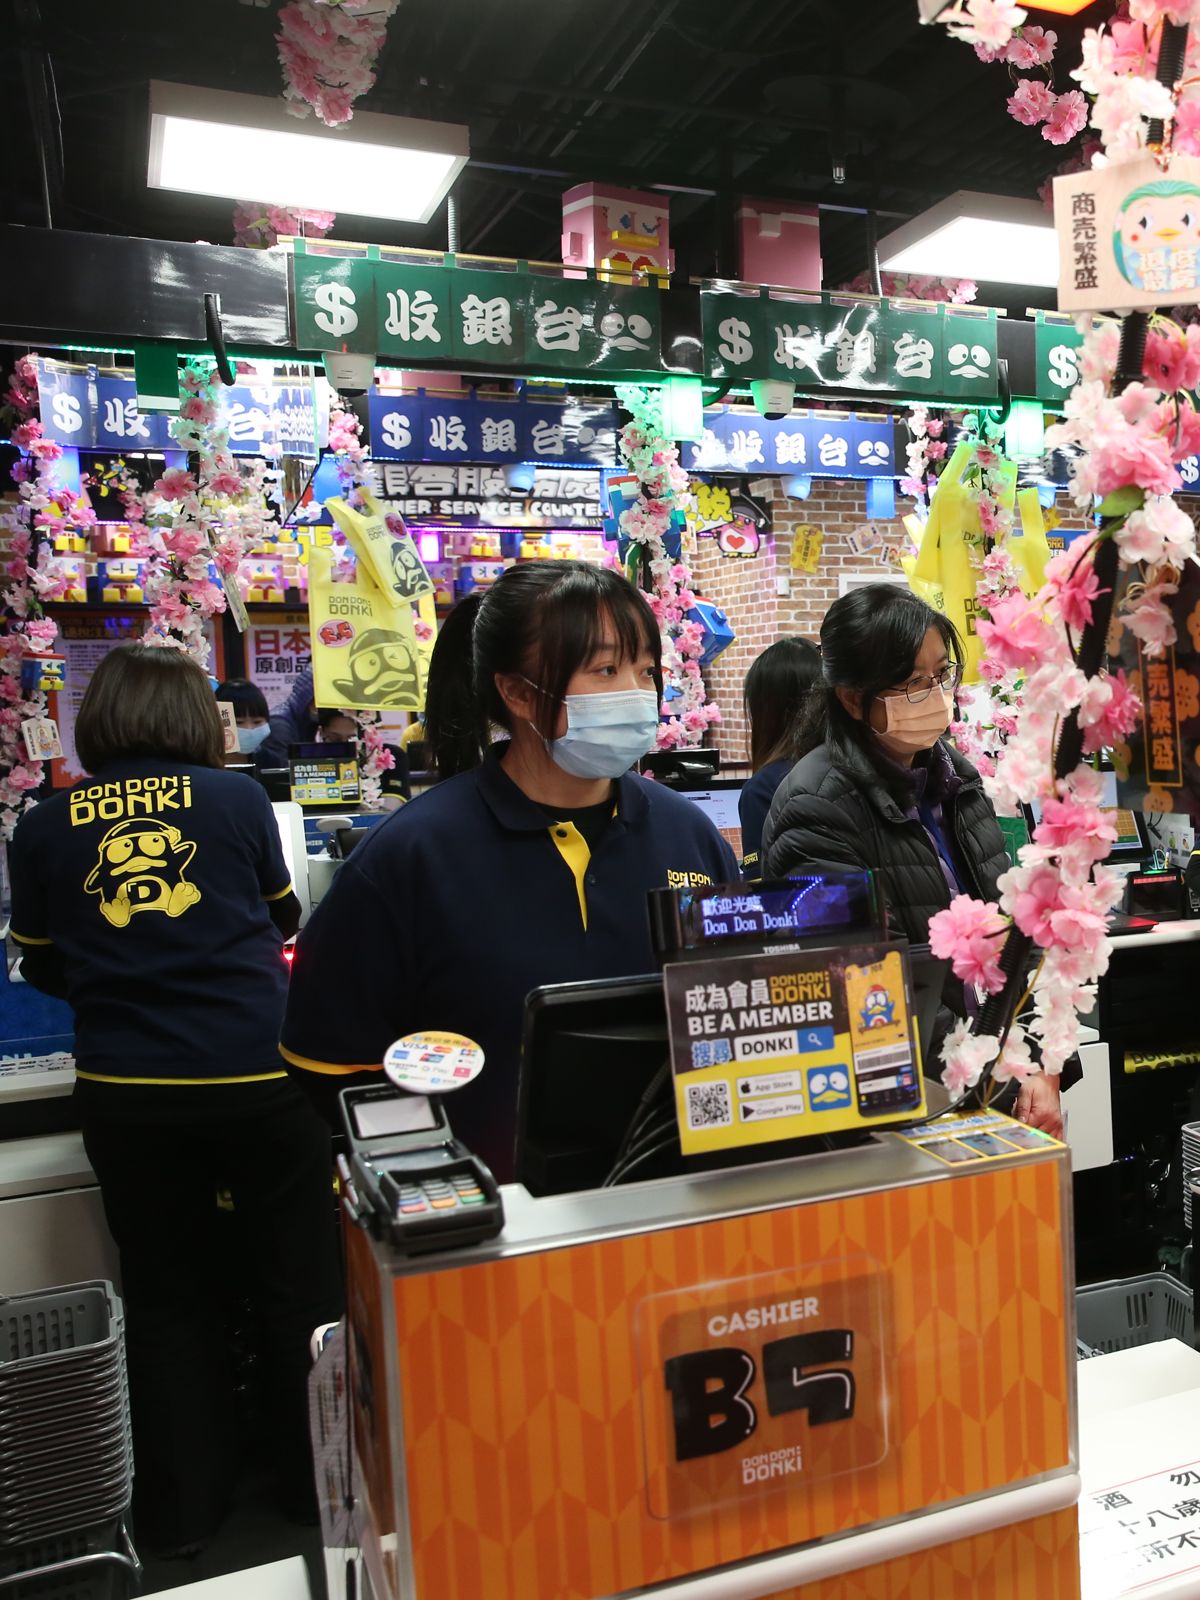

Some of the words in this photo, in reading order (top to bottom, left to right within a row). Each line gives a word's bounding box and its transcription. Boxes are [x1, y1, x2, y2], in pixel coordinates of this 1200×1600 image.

[1071, 192, 1099, 290] 商売繁盛
[385, 289, 586, 351] 收銀台
[774, 323, 934, 379] 收銀台
[429, 416, 564, 455] 收銀台
[441, 500, 525, 515] SERVICE
[329, 605, 373, 617] DONKI
[254, 628, 311, 655] 日本
[1146, 650, 1175, 770] 売繁盛
[70, 782, 121, 803] DON
[125, 776, 178, 794] DON
[70, 786, 192, 826] DONKI
[704, 919, 728, 935] Don
[734, 916, 757, 932] Don
[763, 911, 799, 929] Donki
[763, 943, 800, 954] TOSHIBA
[685, 978, 770, 1013] 成為會員
[770, 981, 832, 1005] DONKI
[687, 1014, 716, 1036] BE
[720, 1013, 736, 1032] A
[739, 1001, 834, 1030] MEMBER
[402, 1042, 429, 1050] VISA
[691, 1038, 733, 1068] 搜尋
[741, 1036, 793, 1056] DONKI
[755, 1082, 772, 1092] App
[773, 1079, 793, 1089] Store
[756, 1106, 783, 1117] Google
[785, 1103, 801, 1113] Play
[707, 1297, 819, 1336] CASHIER
[664, 1328, 856, 1462] B5
[743, 1457, 802, 1485] DONKI
